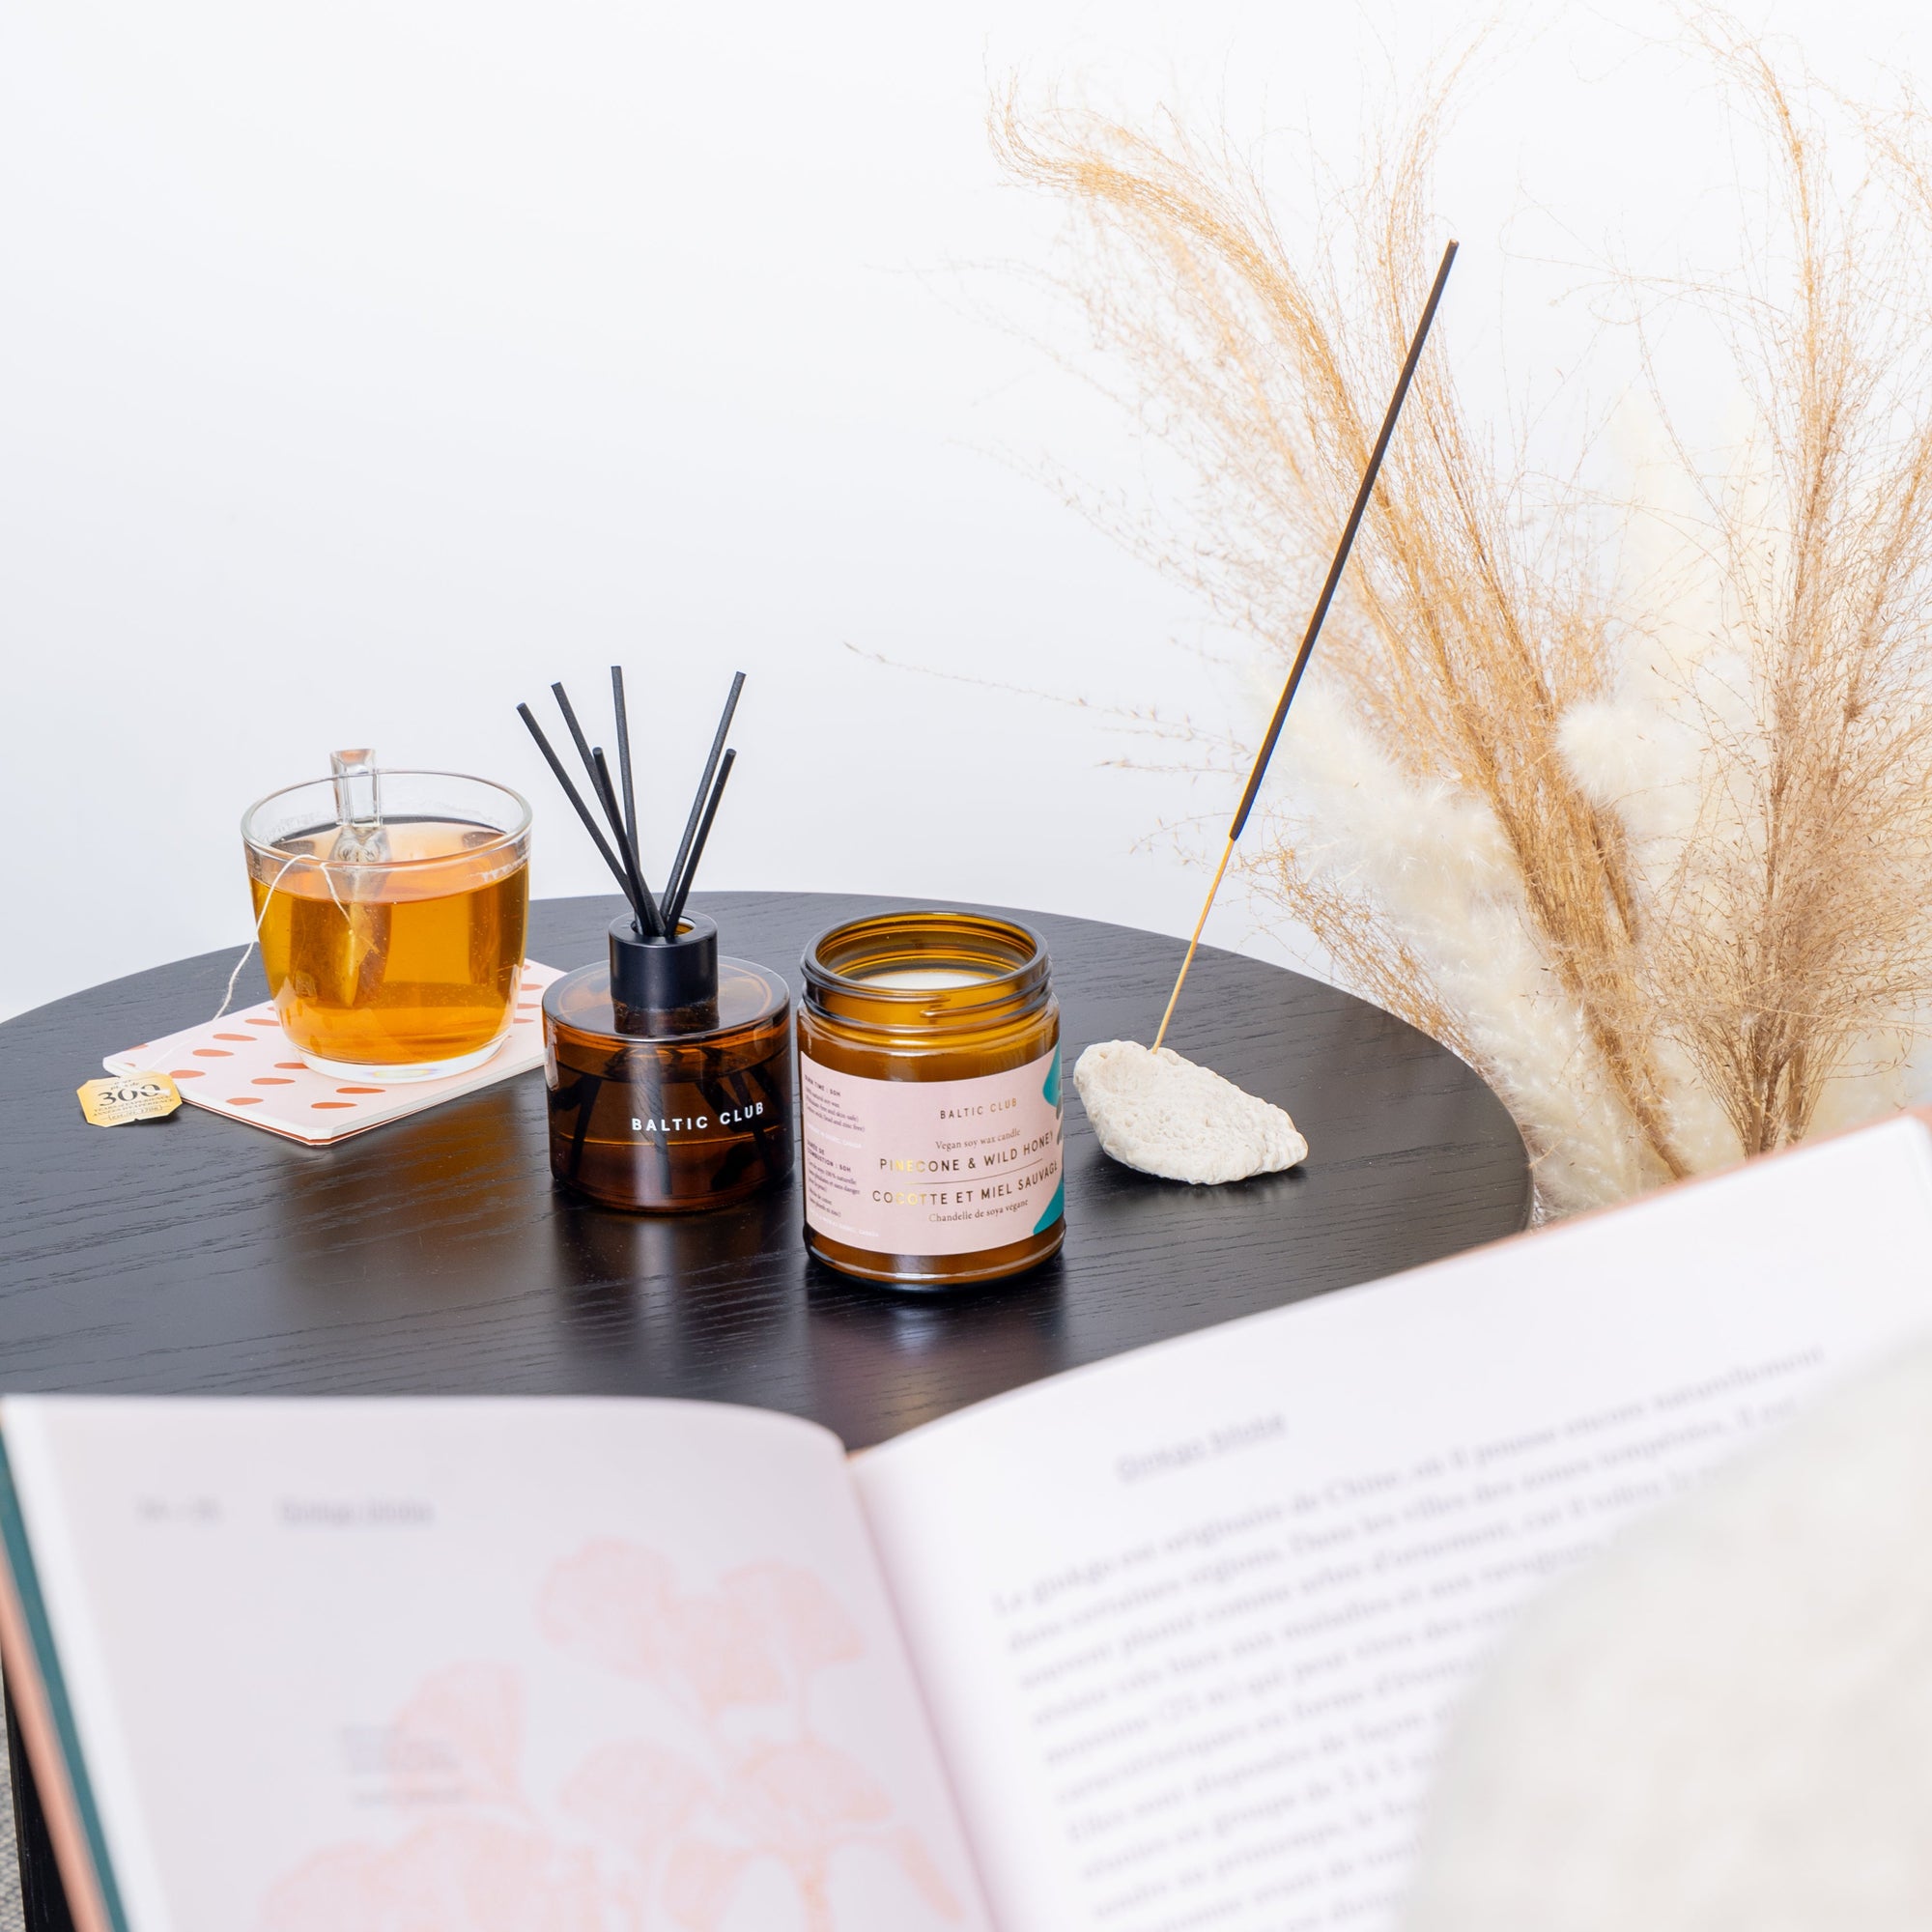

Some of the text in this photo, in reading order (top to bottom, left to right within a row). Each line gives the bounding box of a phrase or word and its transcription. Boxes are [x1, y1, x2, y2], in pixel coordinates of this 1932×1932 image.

[98, 1084, 160, 1106] 300
[632, 1102, 763, 1131] BALTIC CLUB
[940, 1097, 1017, 1119] BALTIC CLUB
[935, 1141, 961, 1151] Vegan
[997, 1128, 1021, 1141] candle
[880, 1158, 960, 1173] PINECONE
[968, 1157, 976, 1169] &
[983, 1148, 1018, 1167] WILD
[872, 1159, 1059, 1206] COCOTTE ET MIEL SAUVAGE
[928, 1211, 973, 1223] Chandelle
[975, 1209, 983, 1219] de
[986, 1207, 1004, 1217] soya
